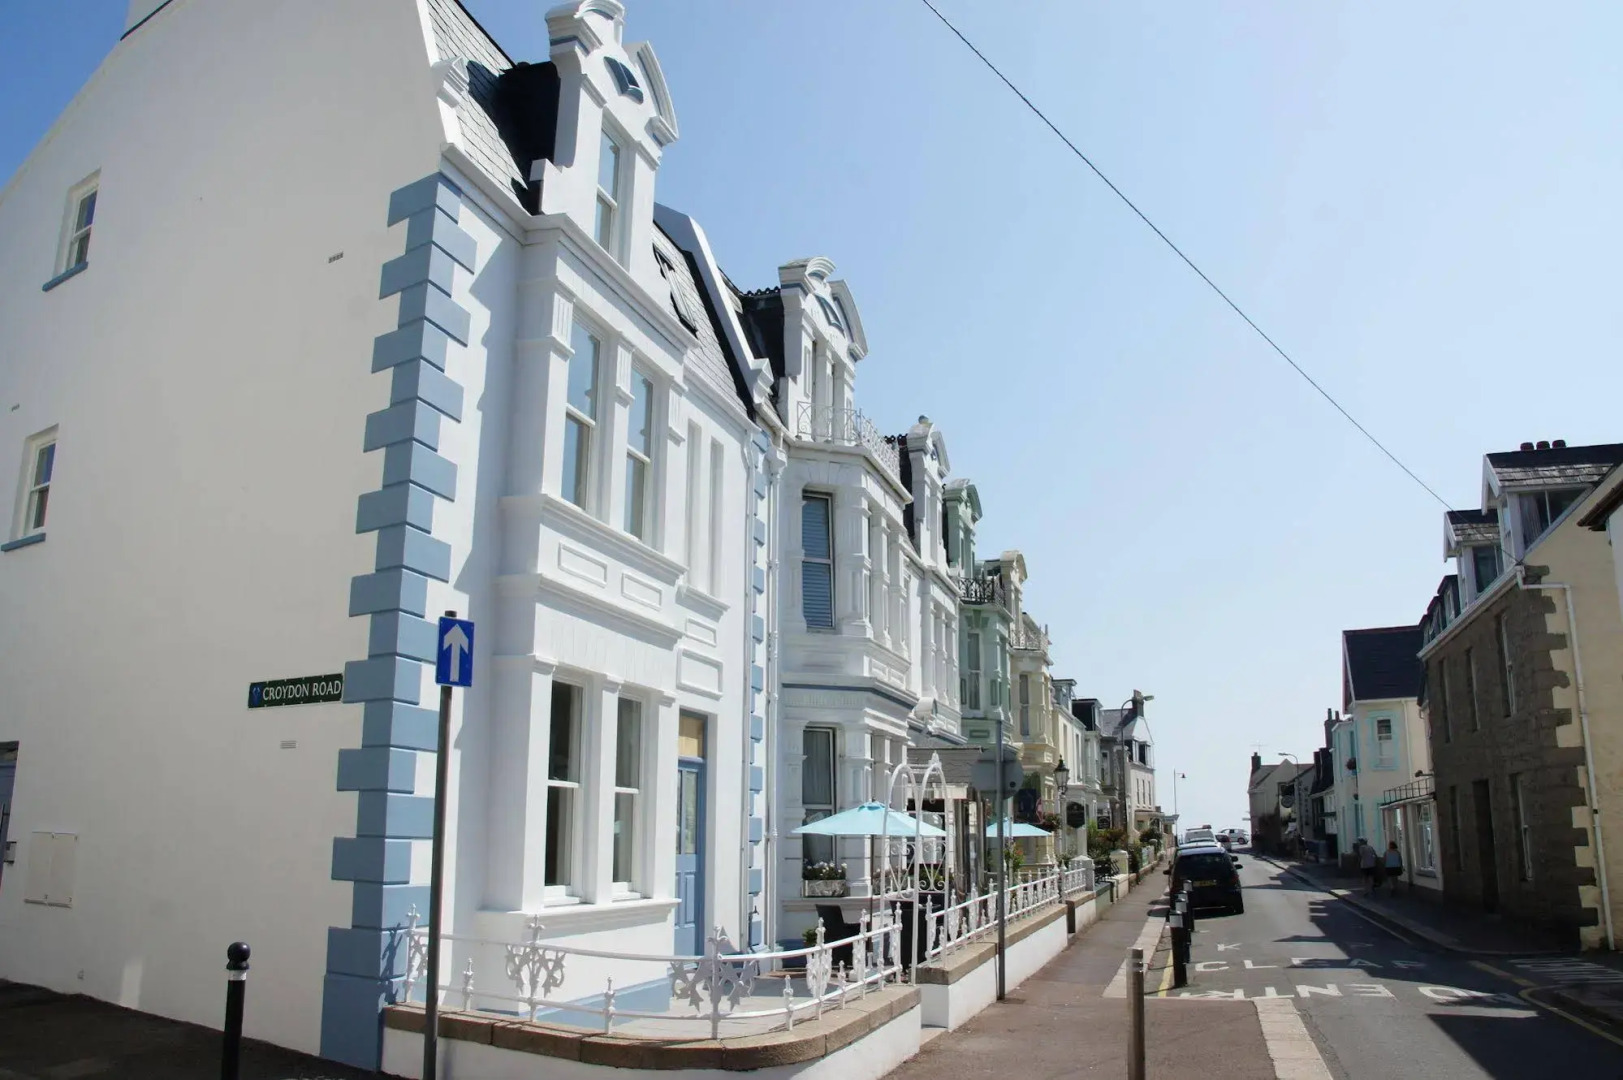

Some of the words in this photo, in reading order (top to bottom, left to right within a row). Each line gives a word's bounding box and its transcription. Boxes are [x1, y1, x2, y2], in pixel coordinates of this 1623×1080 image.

[263, 684, 310, 701] CROYDON
[312, 681, 342, 696] ROAD
[1195, 957, 1426, 971] CLEAR
